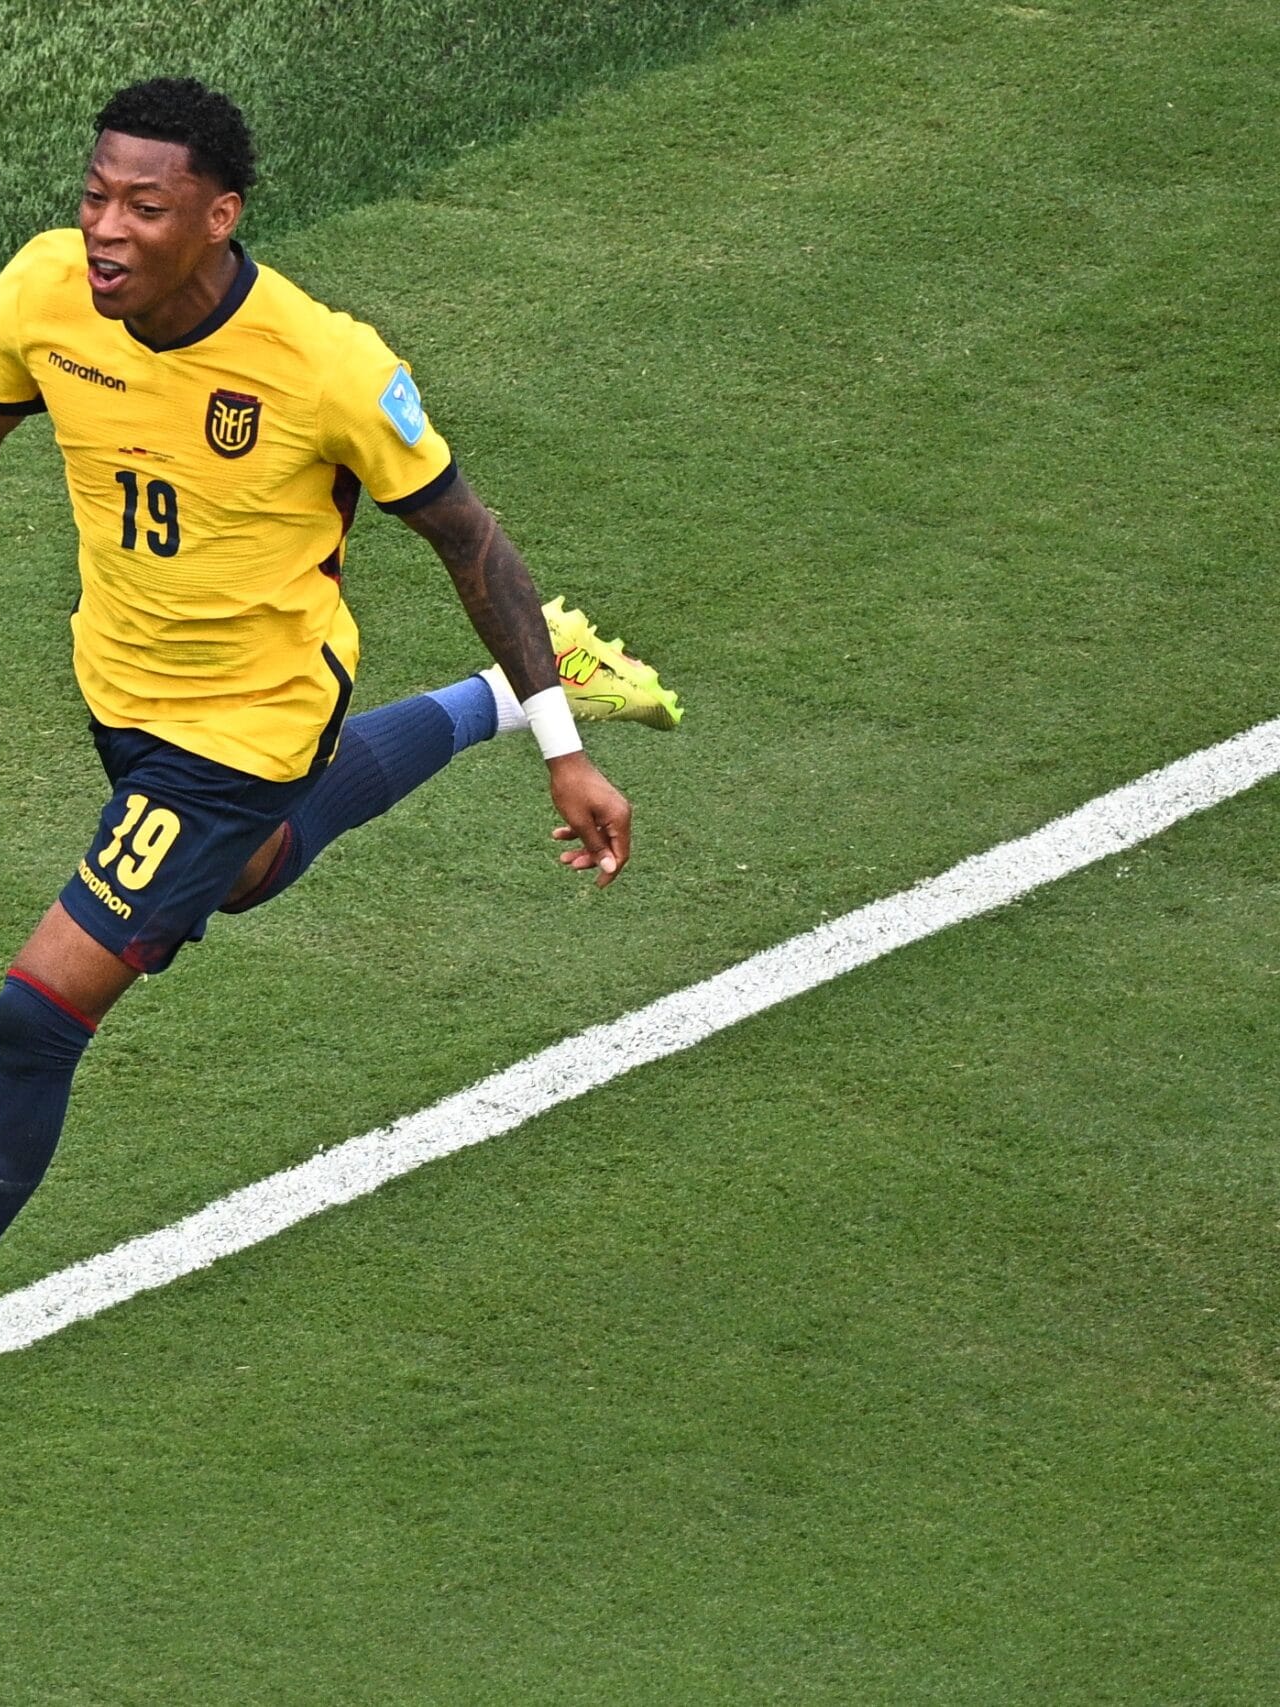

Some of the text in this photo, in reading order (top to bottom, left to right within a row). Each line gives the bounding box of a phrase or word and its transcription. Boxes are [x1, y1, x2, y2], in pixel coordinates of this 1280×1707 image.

[48, 351, 126, 392] marathon
[115, 470, 180, 558] 19
[98, 793, 181, 891] 19
